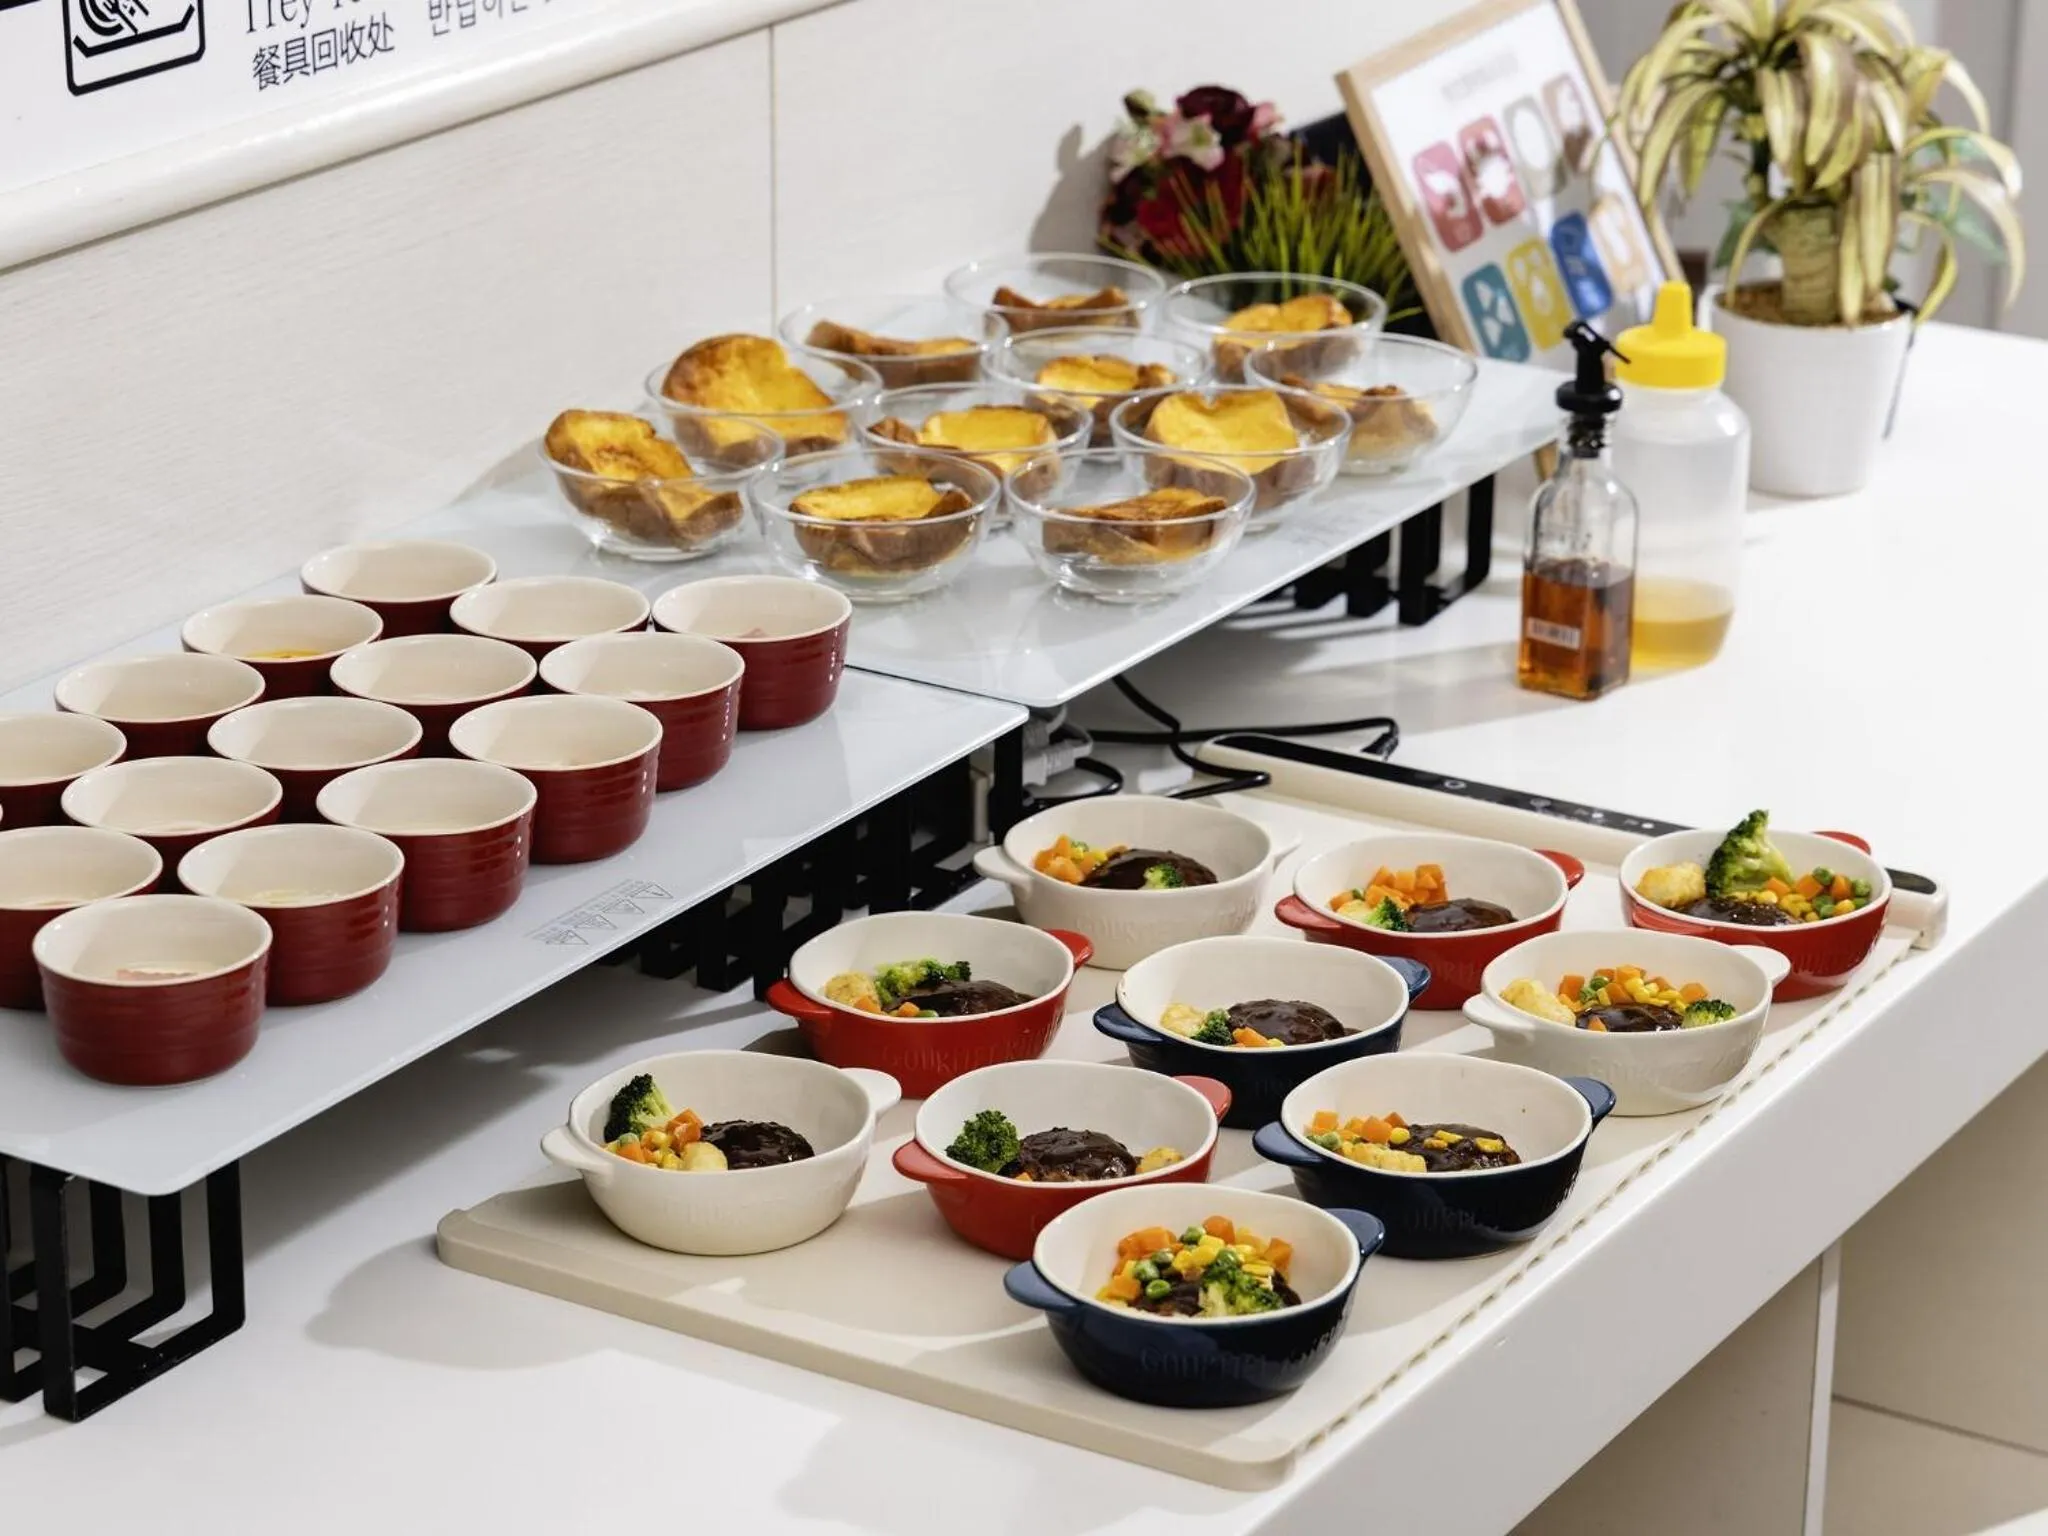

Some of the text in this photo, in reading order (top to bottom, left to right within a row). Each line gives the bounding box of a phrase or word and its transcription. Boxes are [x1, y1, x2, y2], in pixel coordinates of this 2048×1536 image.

[253, 11, 395, 91] 餐具回收处
